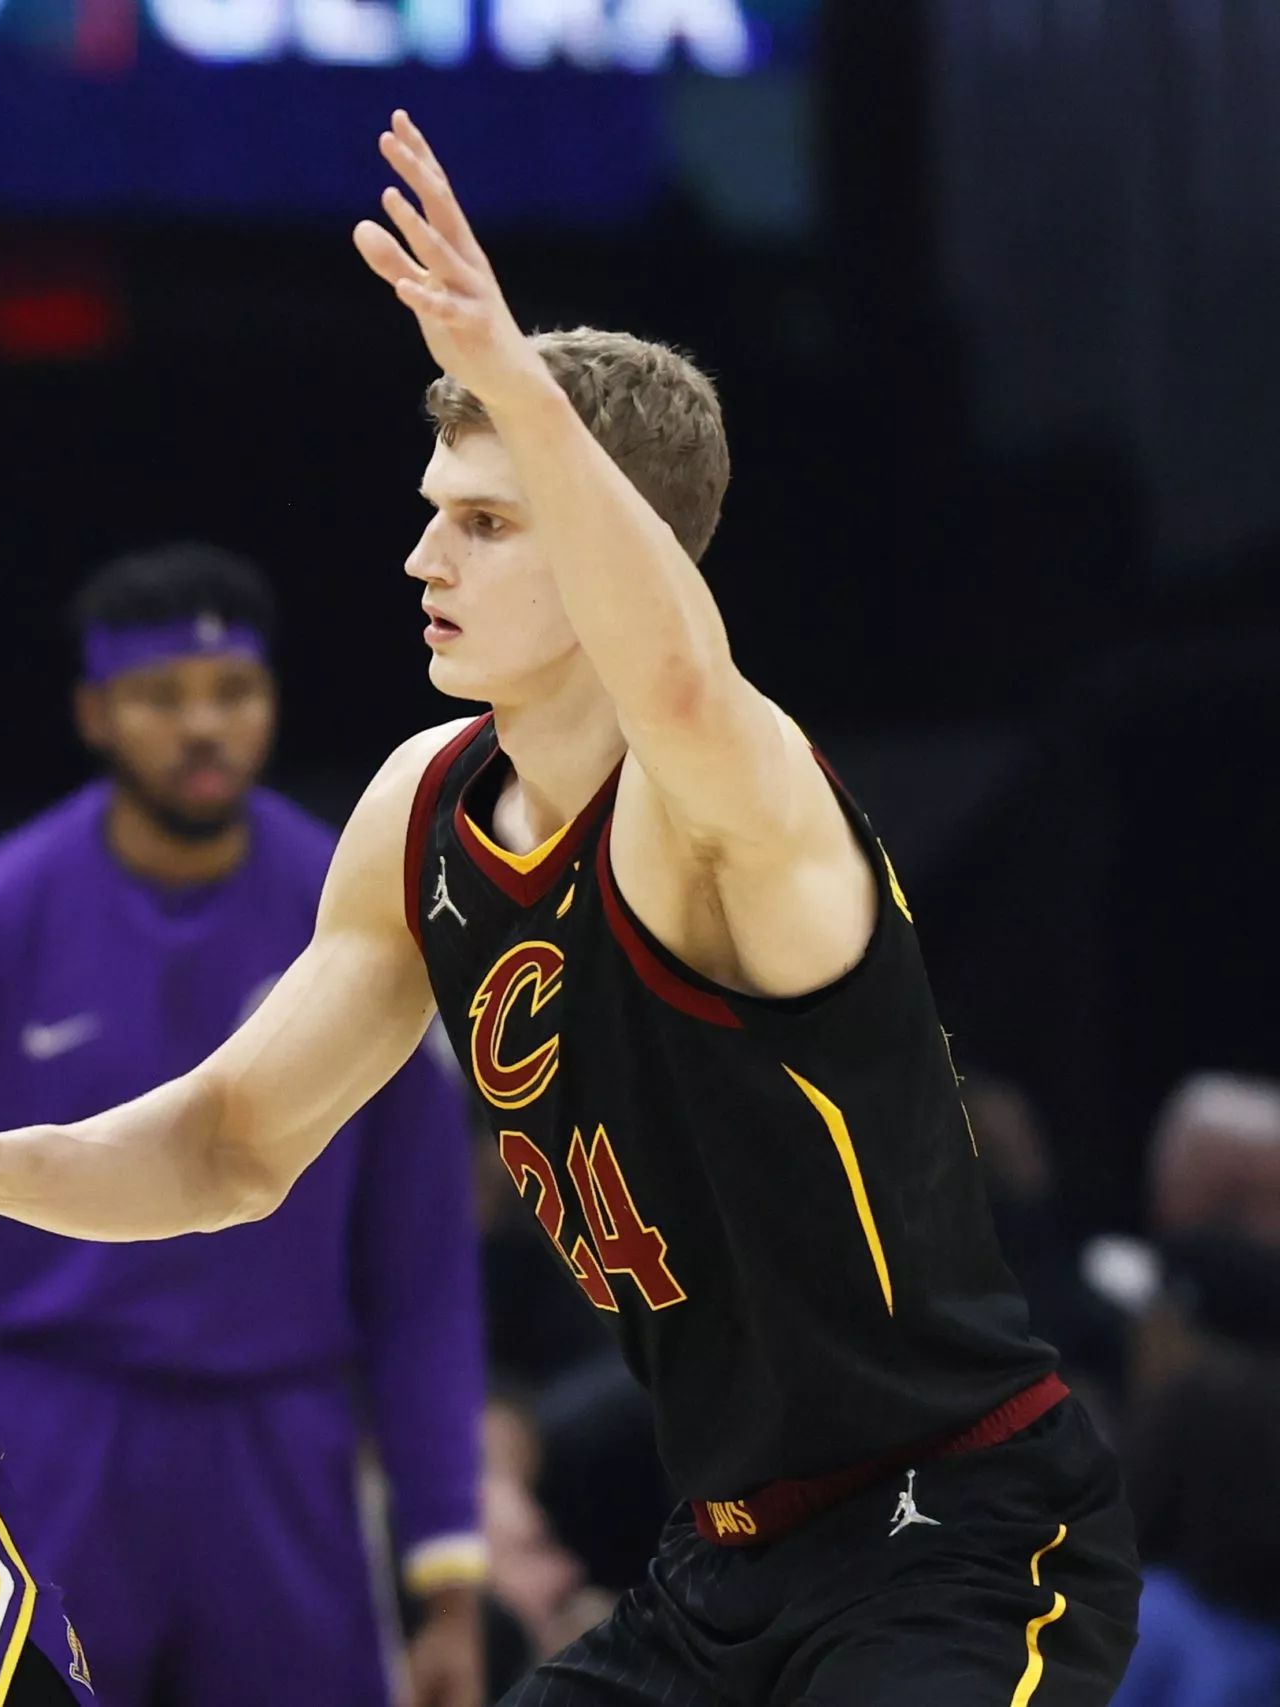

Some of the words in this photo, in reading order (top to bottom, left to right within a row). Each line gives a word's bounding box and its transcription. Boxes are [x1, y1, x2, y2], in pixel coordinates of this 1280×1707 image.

[468, 940, 565, 1110] C
[499, 1122, 688, 1313] 24
[706, 1499, 757, 1538] AVS
